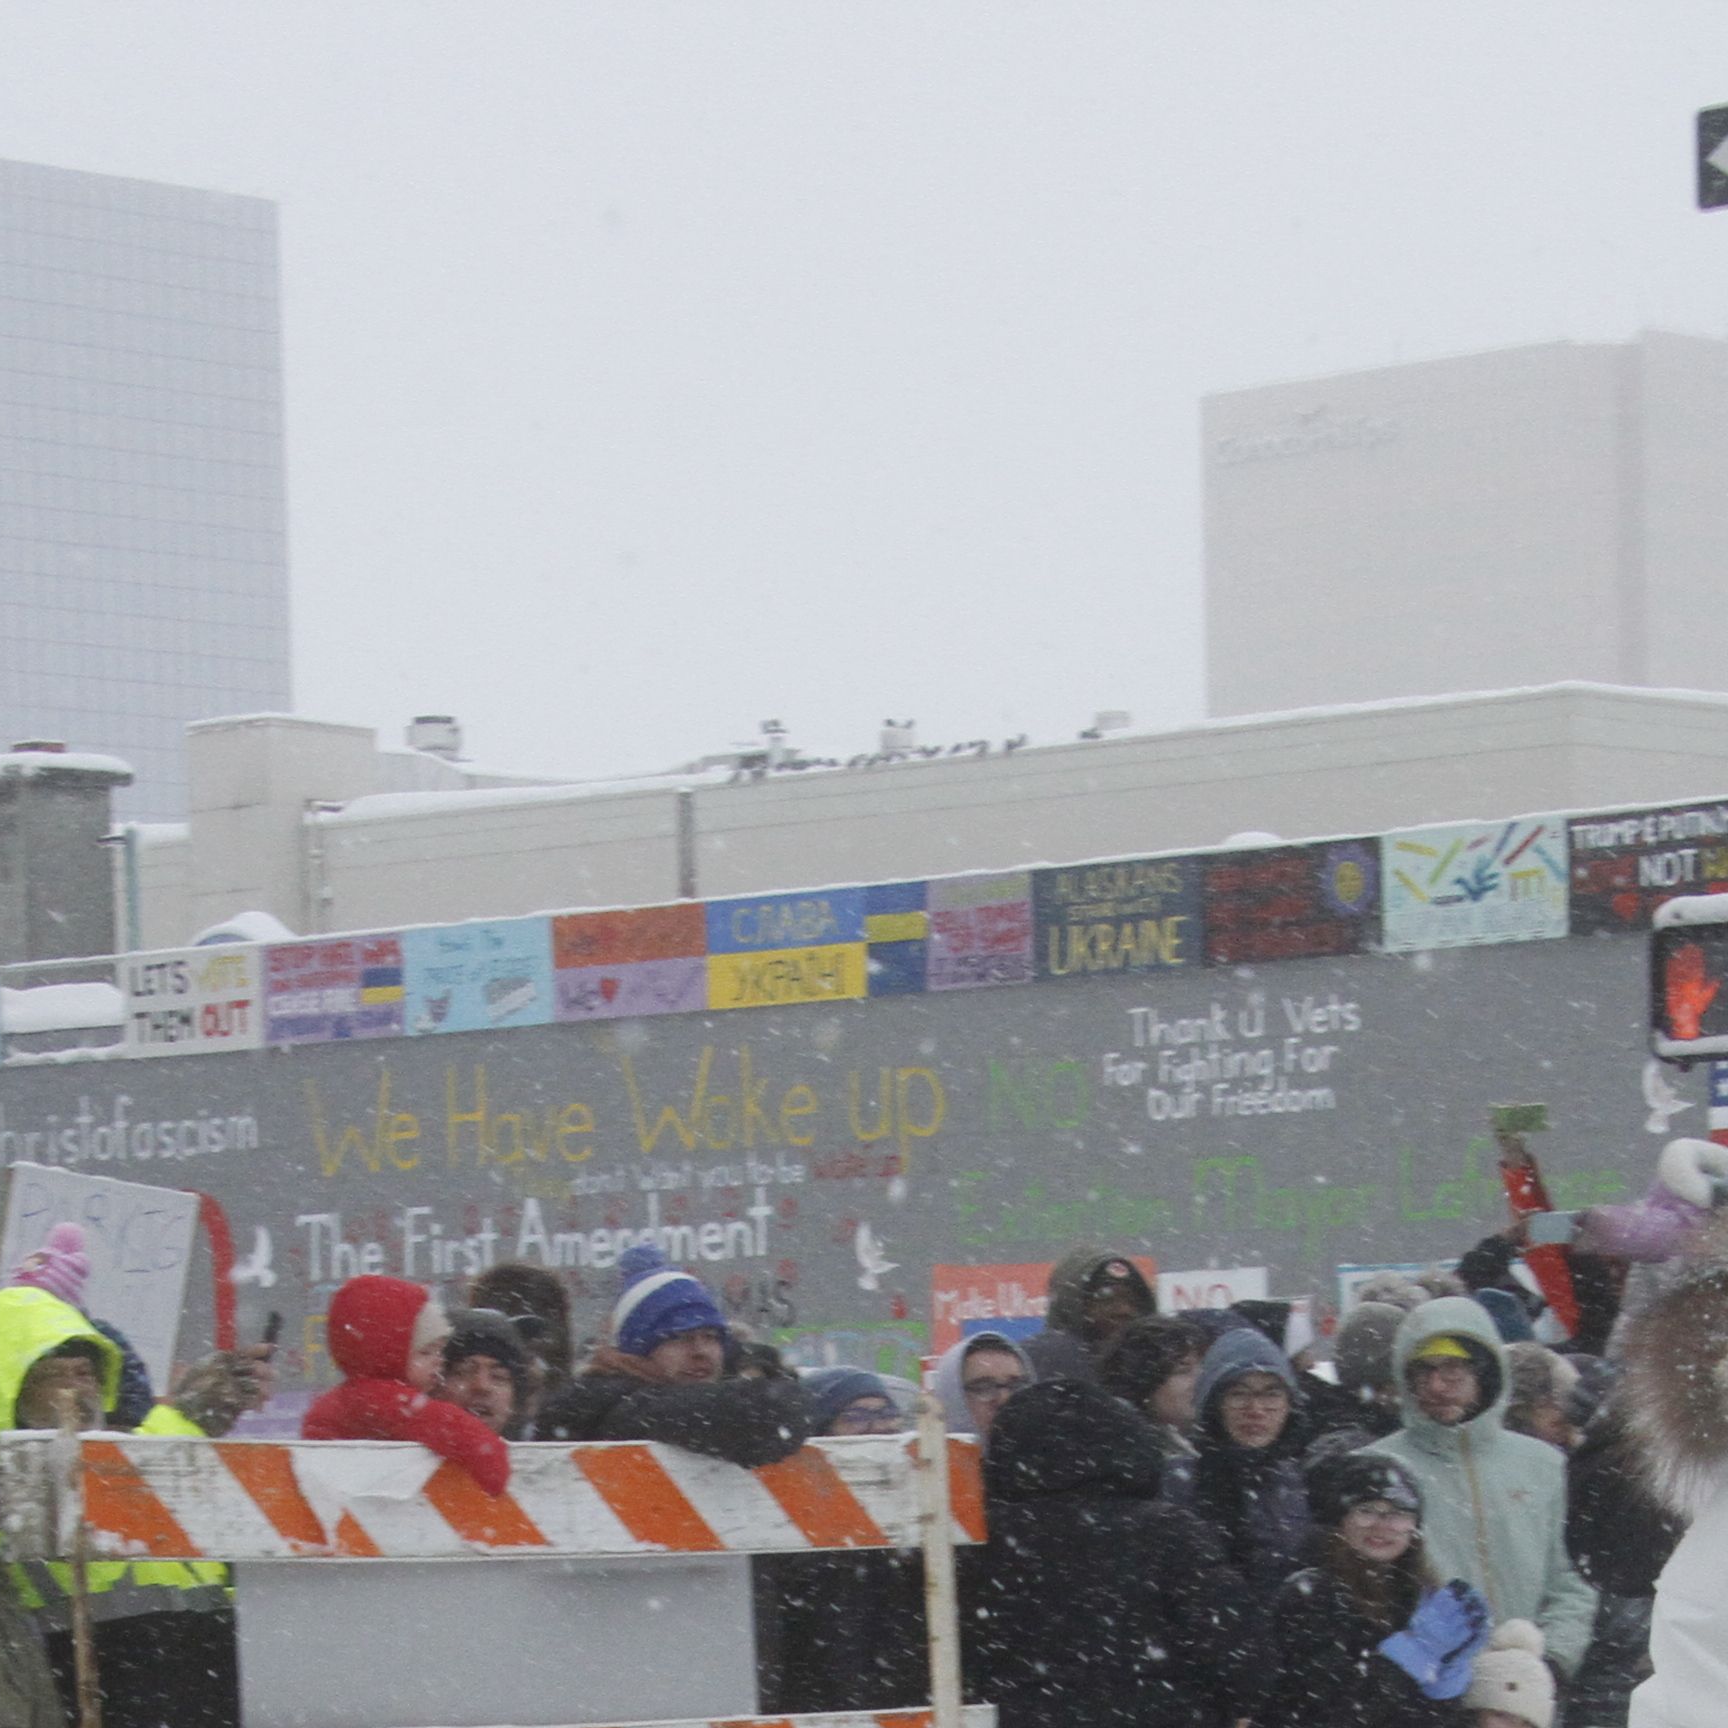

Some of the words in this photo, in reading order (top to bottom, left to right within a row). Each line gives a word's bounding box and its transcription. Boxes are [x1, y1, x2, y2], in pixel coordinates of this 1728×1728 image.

[1637, 847, 1698, 889] NOT
[1048, 915, 1191, 976] UKRAINE
[133, 1007, 198, 1043] THEM
[200, 999, 251, 1039] OUT
[1125, 1001, 1233, 1048] Thank
[1280, 994, 1363, 1035] Vets
[1103, 1052, 1148, 1087] For
[1284, 1036, 1341, 1075] For
[306, 1076, 422, 1178] We
[445, 1064, 596, 1168] Have
[622, 1043, 820, 1152] Woke
[295, 1210, 385, 1281] The
[397, 1205, 499, 1276] First
[516, 1186, 773, 1269] Amendment
